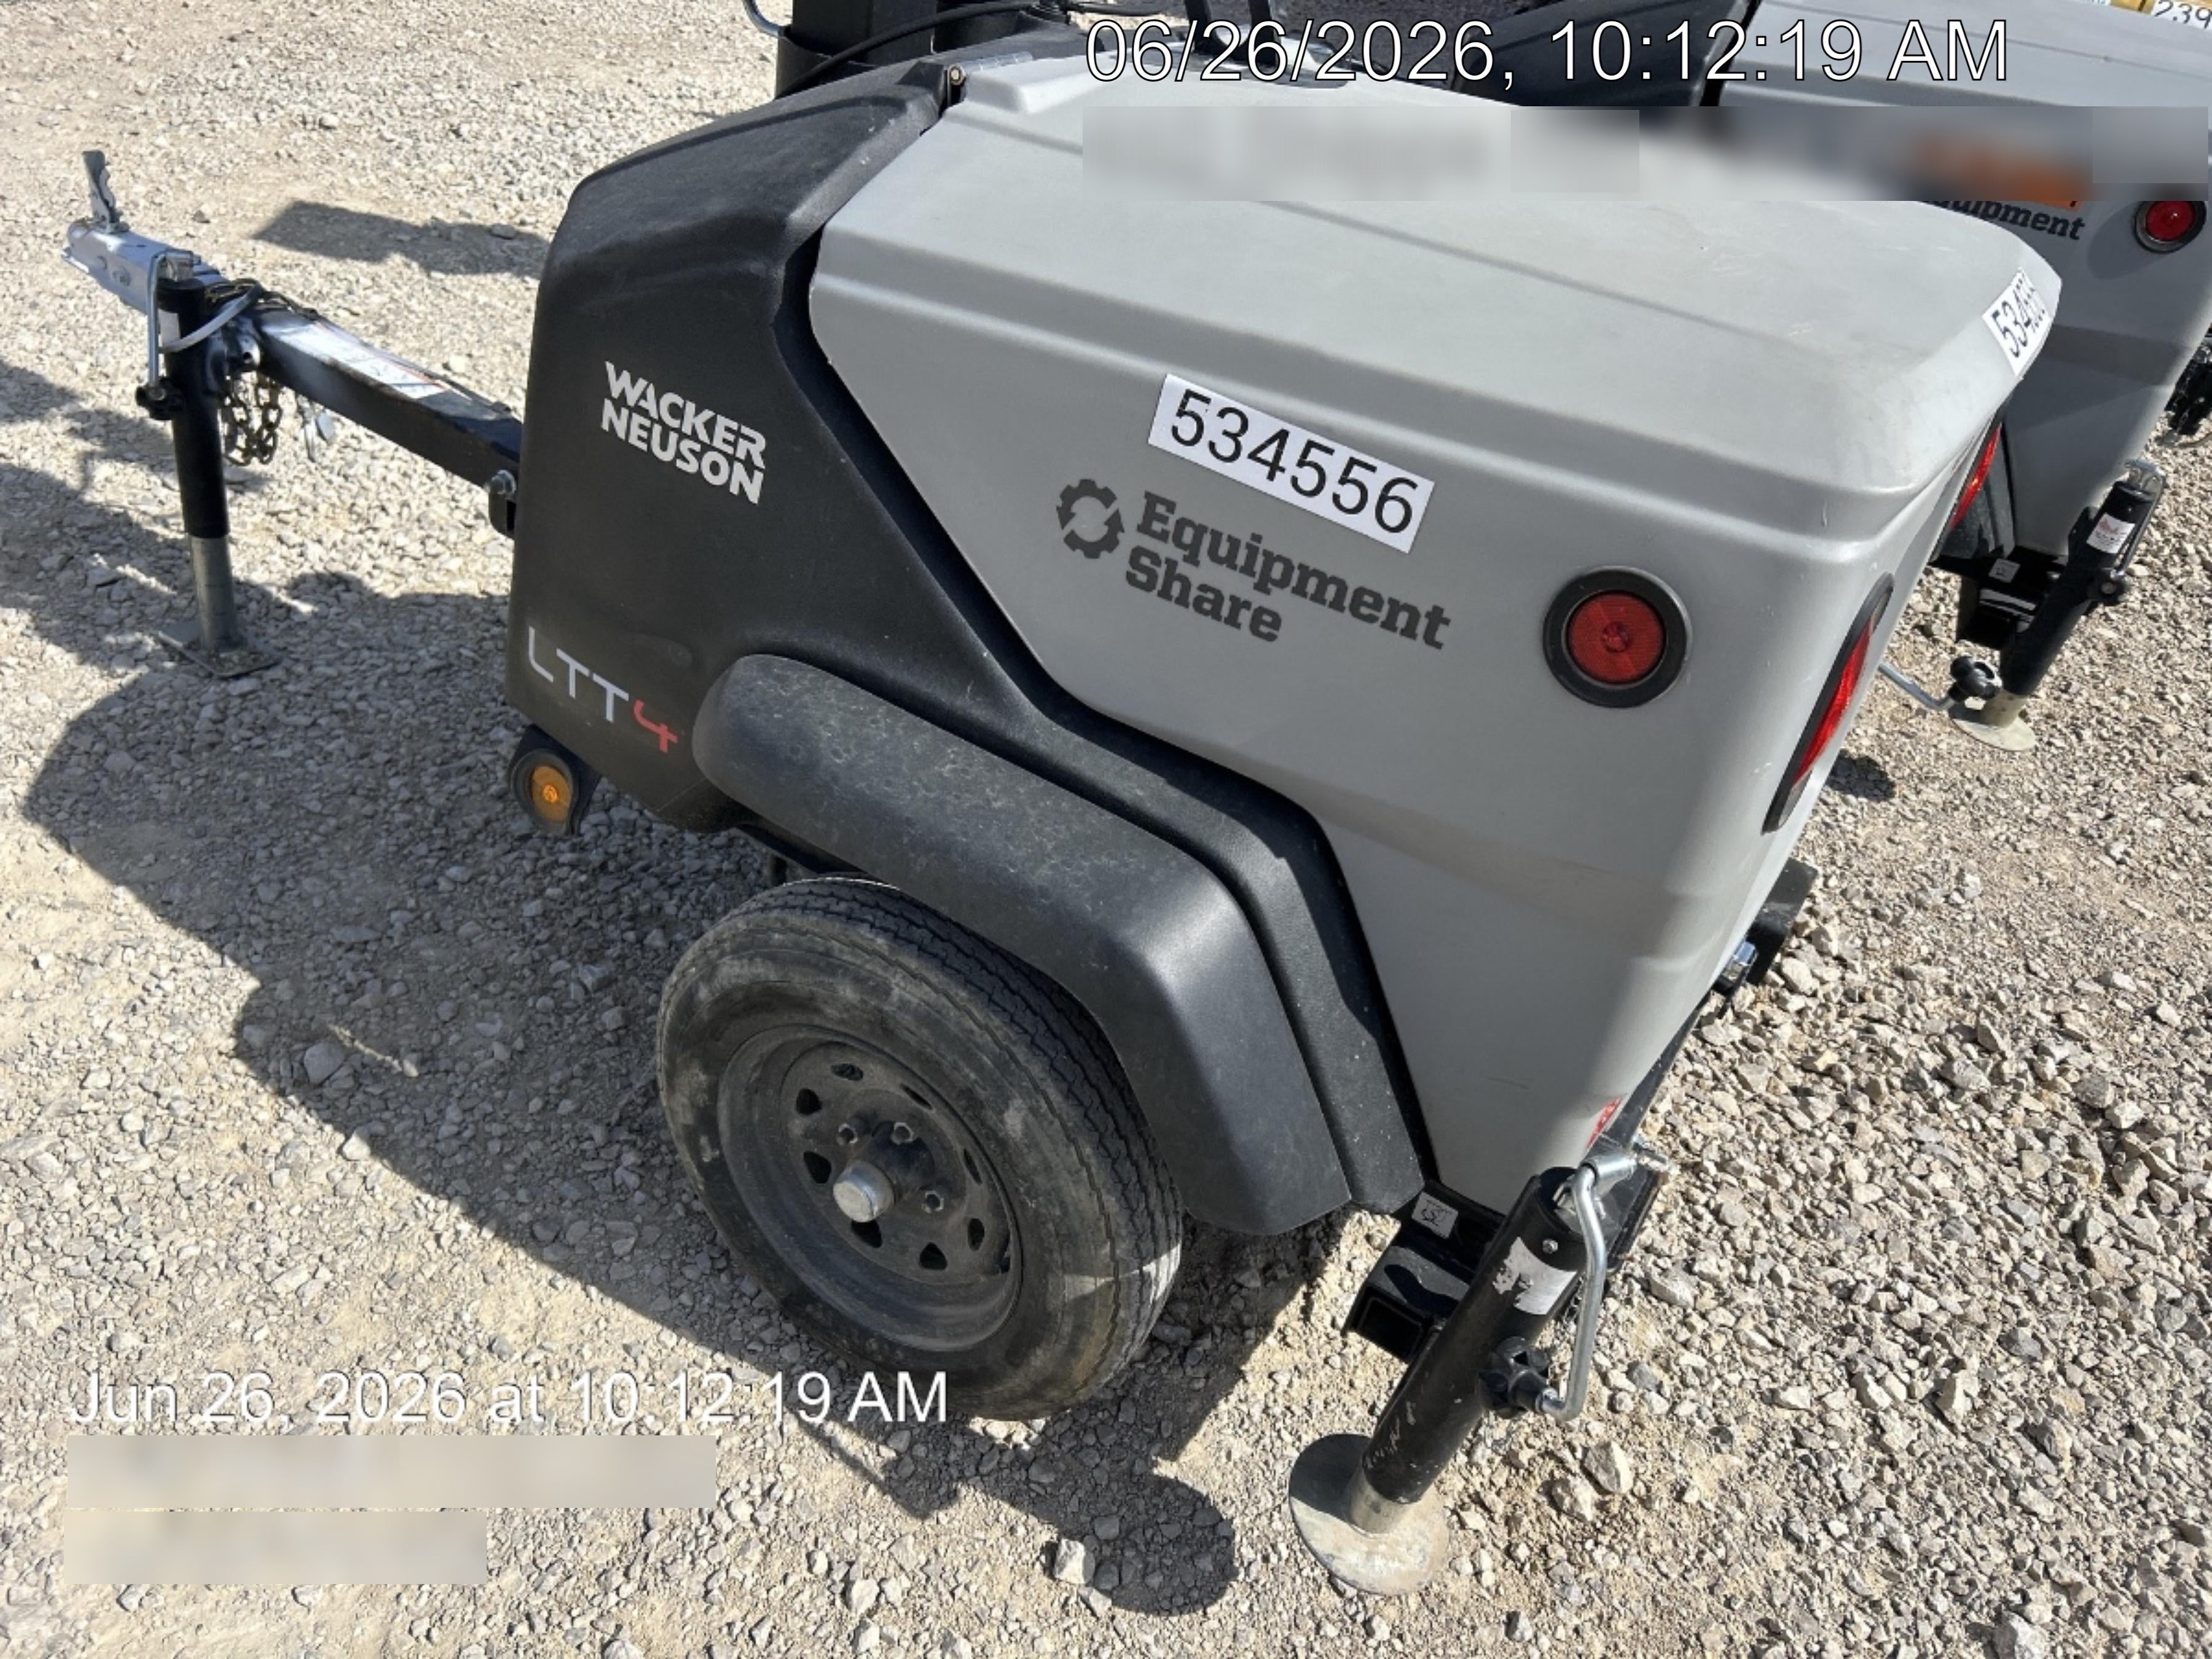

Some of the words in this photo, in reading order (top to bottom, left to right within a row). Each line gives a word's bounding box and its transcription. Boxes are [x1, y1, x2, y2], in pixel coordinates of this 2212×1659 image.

[601, 398, 764, 505] NEUSON
[605, 361, 766, 469] WACKER
[1171, 389, 1418, 534] 534556
[1126, 545, 1282, 643] Share
[1136, 491, 1451, 650] Equipment
